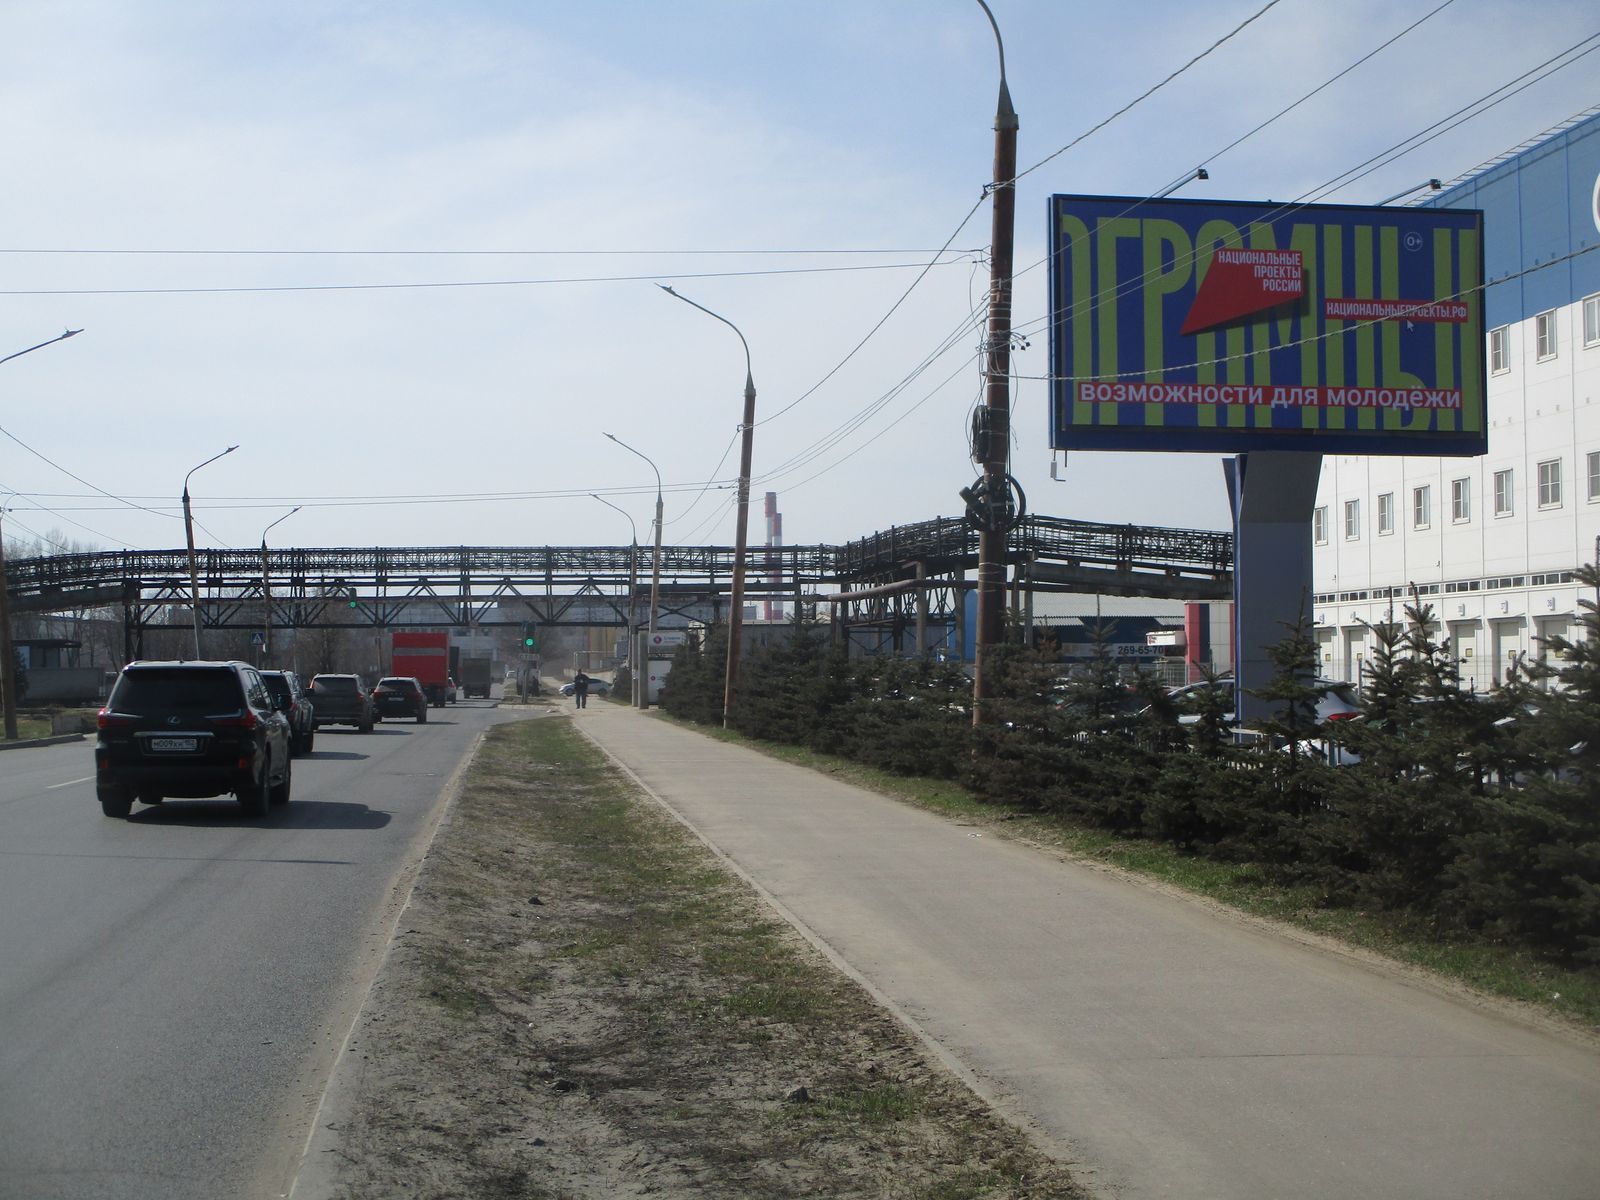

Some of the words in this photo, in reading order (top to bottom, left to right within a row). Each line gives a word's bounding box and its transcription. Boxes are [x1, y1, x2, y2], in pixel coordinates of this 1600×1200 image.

[1406, 236, 1422, 247] 0+
[1218, 250, 1301, 265] НАЦИОНАЛЬНЫЕ
[1254, 265, 1301, 278] ПРОЕКТЫ
[1263, 279, 1301, 292] РОССИИ
[1326, 302, 1467, 318] НАЦИОНАЛЬНЫЕПРОЕКТЫ.РФ
[1118, 645, 1164, 655] 269-65-70
